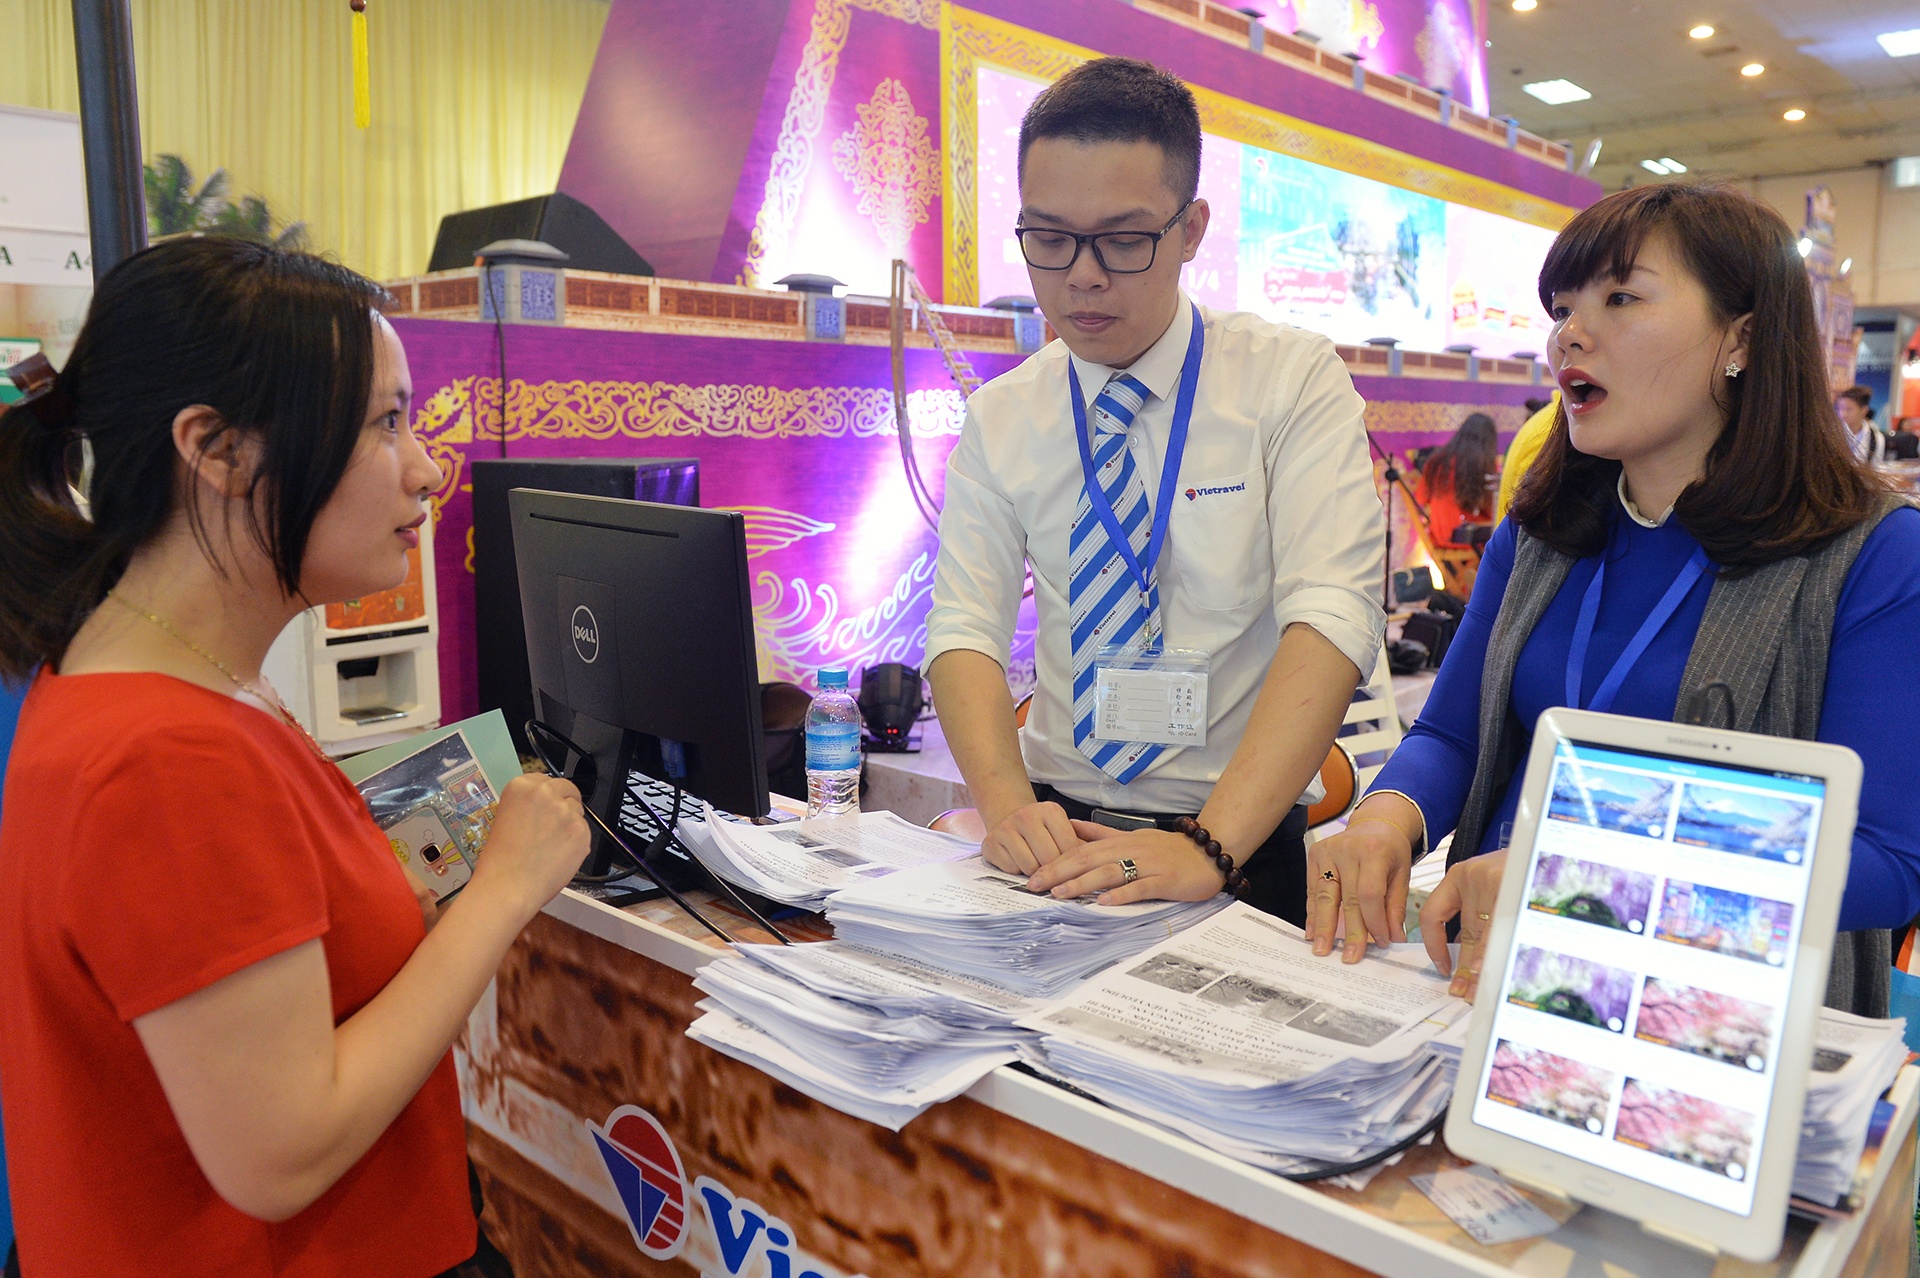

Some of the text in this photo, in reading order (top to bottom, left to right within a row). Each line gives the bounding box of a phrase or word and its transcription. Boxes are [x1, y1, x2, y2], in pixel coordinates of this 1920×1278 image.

[1196, 481, 1246, 497] Vietravel
[1071, 556, 1089, 577] Vietravel
[1098, 610, 1118, 630] Vietravel
[574, 625, 596, 644] DELL
[701, 1187, 823, 1278] Vi
